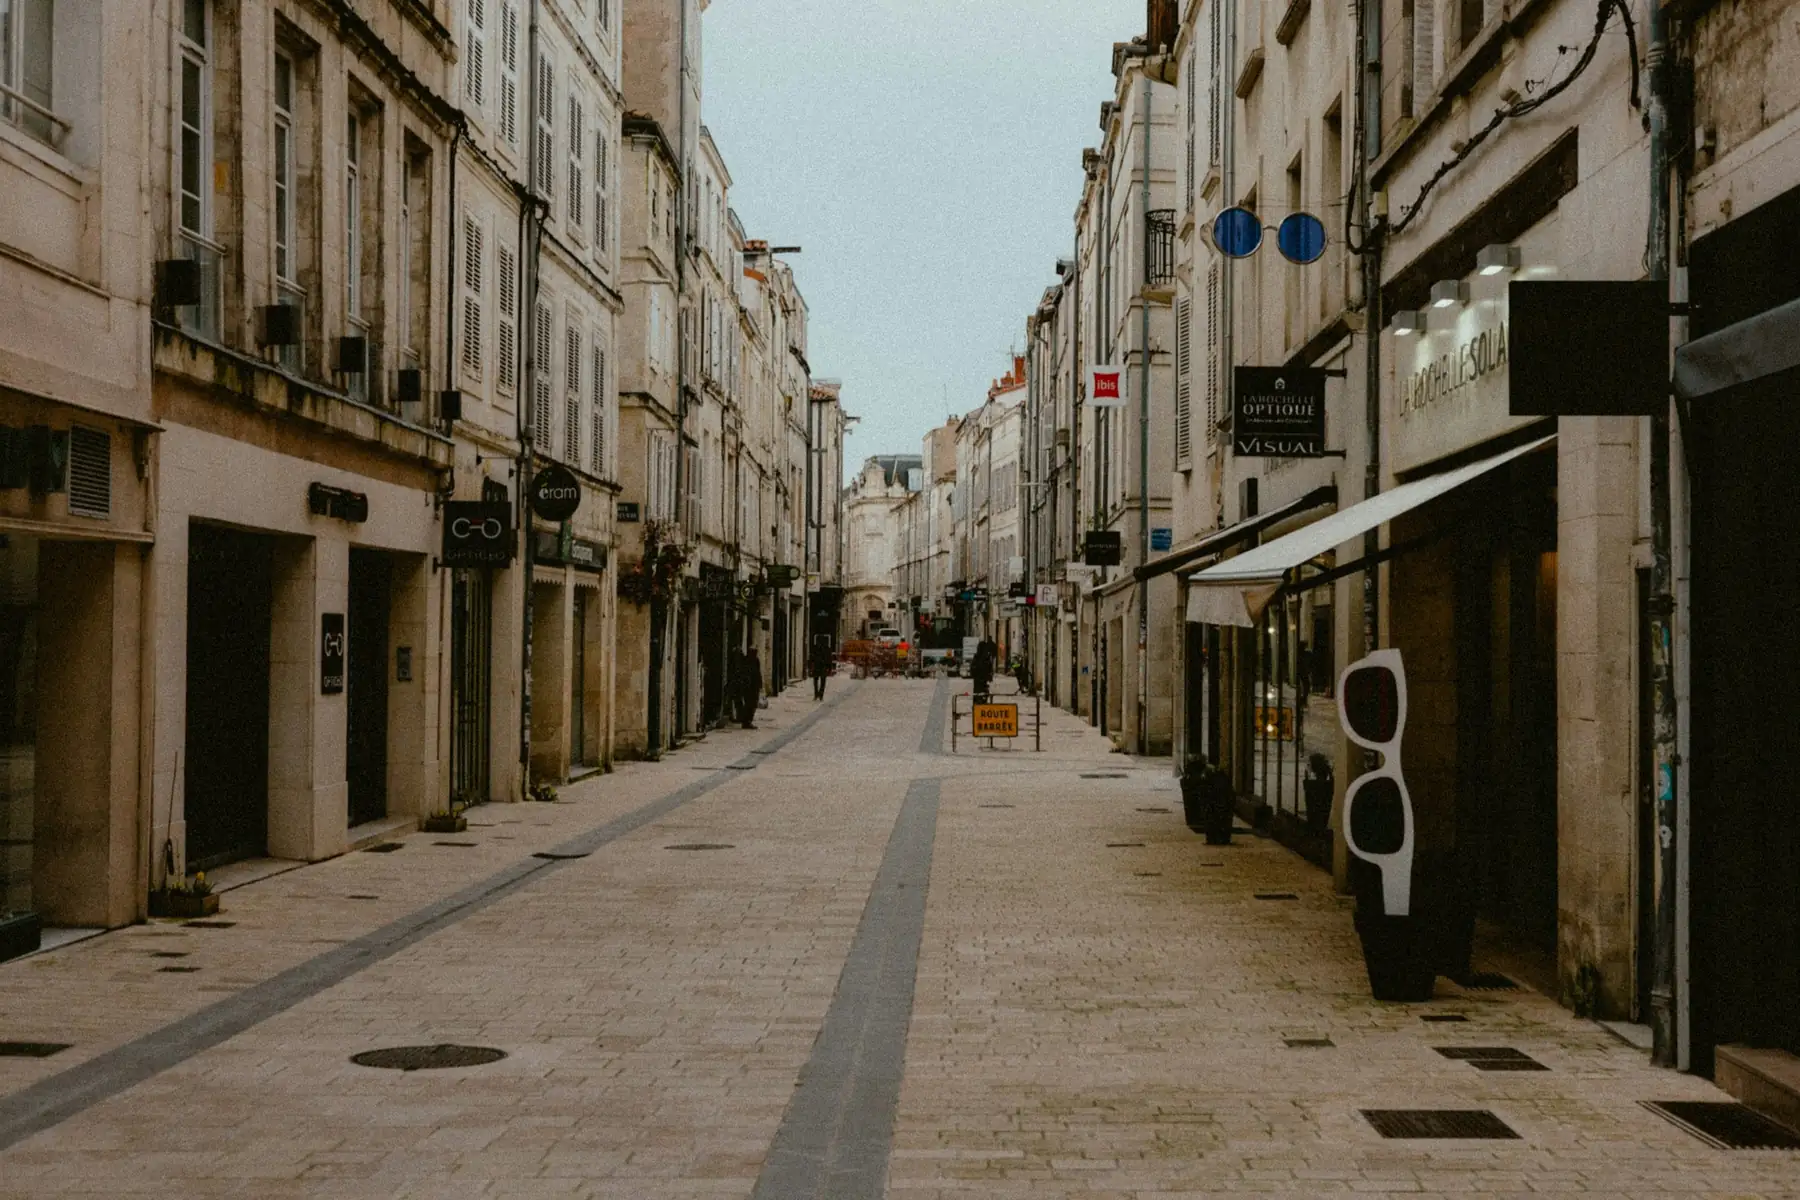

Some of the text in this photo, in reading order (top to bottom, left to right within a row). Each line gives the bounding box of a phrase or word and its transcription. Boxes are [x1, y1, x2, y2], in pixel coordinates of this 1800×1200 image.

[1096, 379, 1117, 392] ibis
[1242, 403, 1316, 416] OPTIQUE
[1238, 437, 1321, 454] VISUAL
[538, 483, 577, 500] éram
[980, 709, 1009, 719] ROUTE
